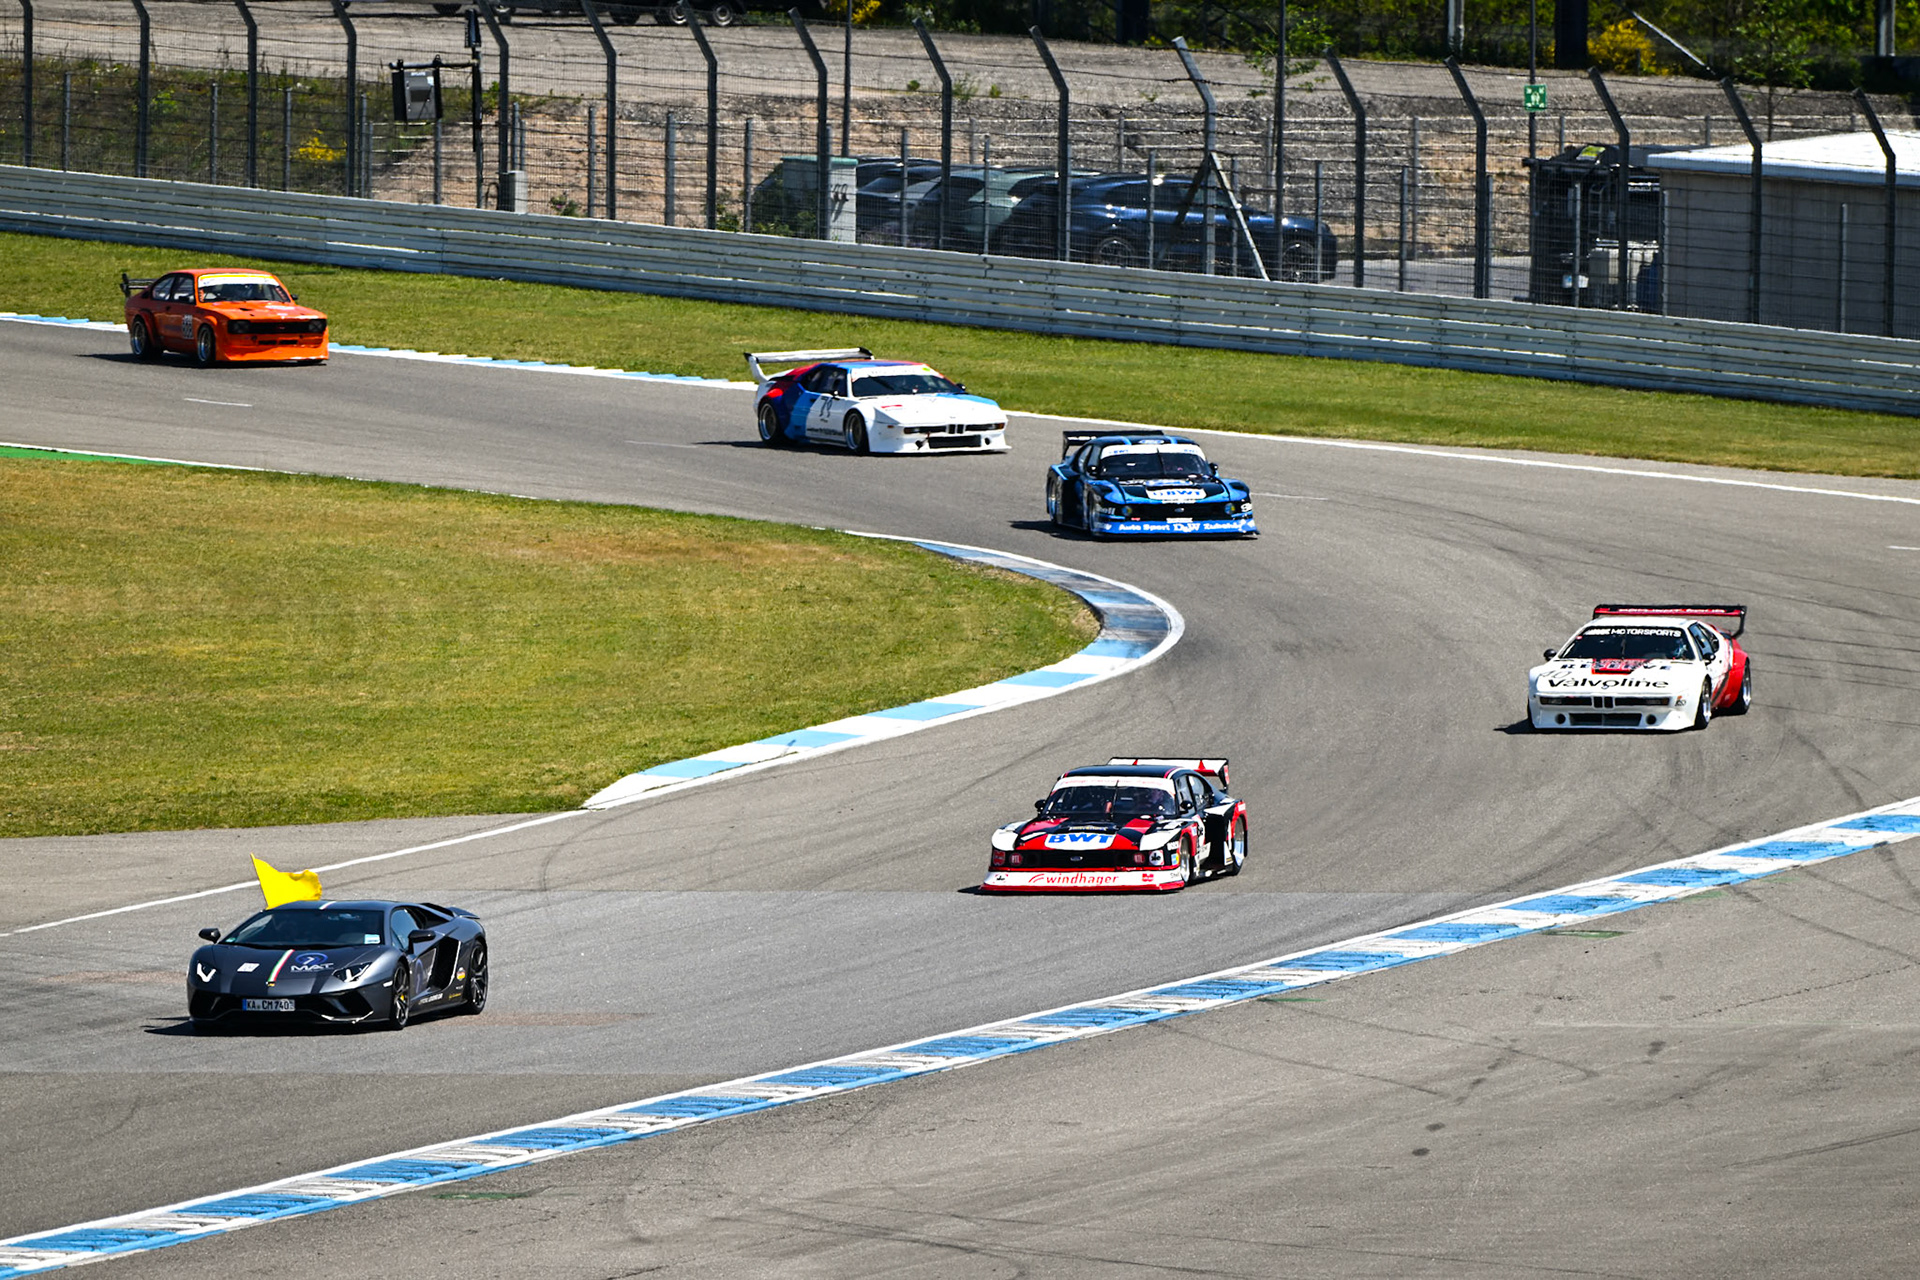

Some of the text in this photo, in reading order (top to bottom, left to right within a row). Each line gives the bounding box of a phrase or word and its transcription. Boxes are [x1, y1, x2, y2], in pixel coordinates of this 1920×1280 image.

[1119, 523, 1142, 531] Auto
[1143, 523, 1170, 532] Sport
[1611, 628, 1682, 638] MOTORSPORTS
[1548, 678, 1669, 687] Valvoline
[1048, 833, 1113, 843] BWT
[1046, 872, 1119, 886] windhager
[290, 963, 334, 972] MAT
